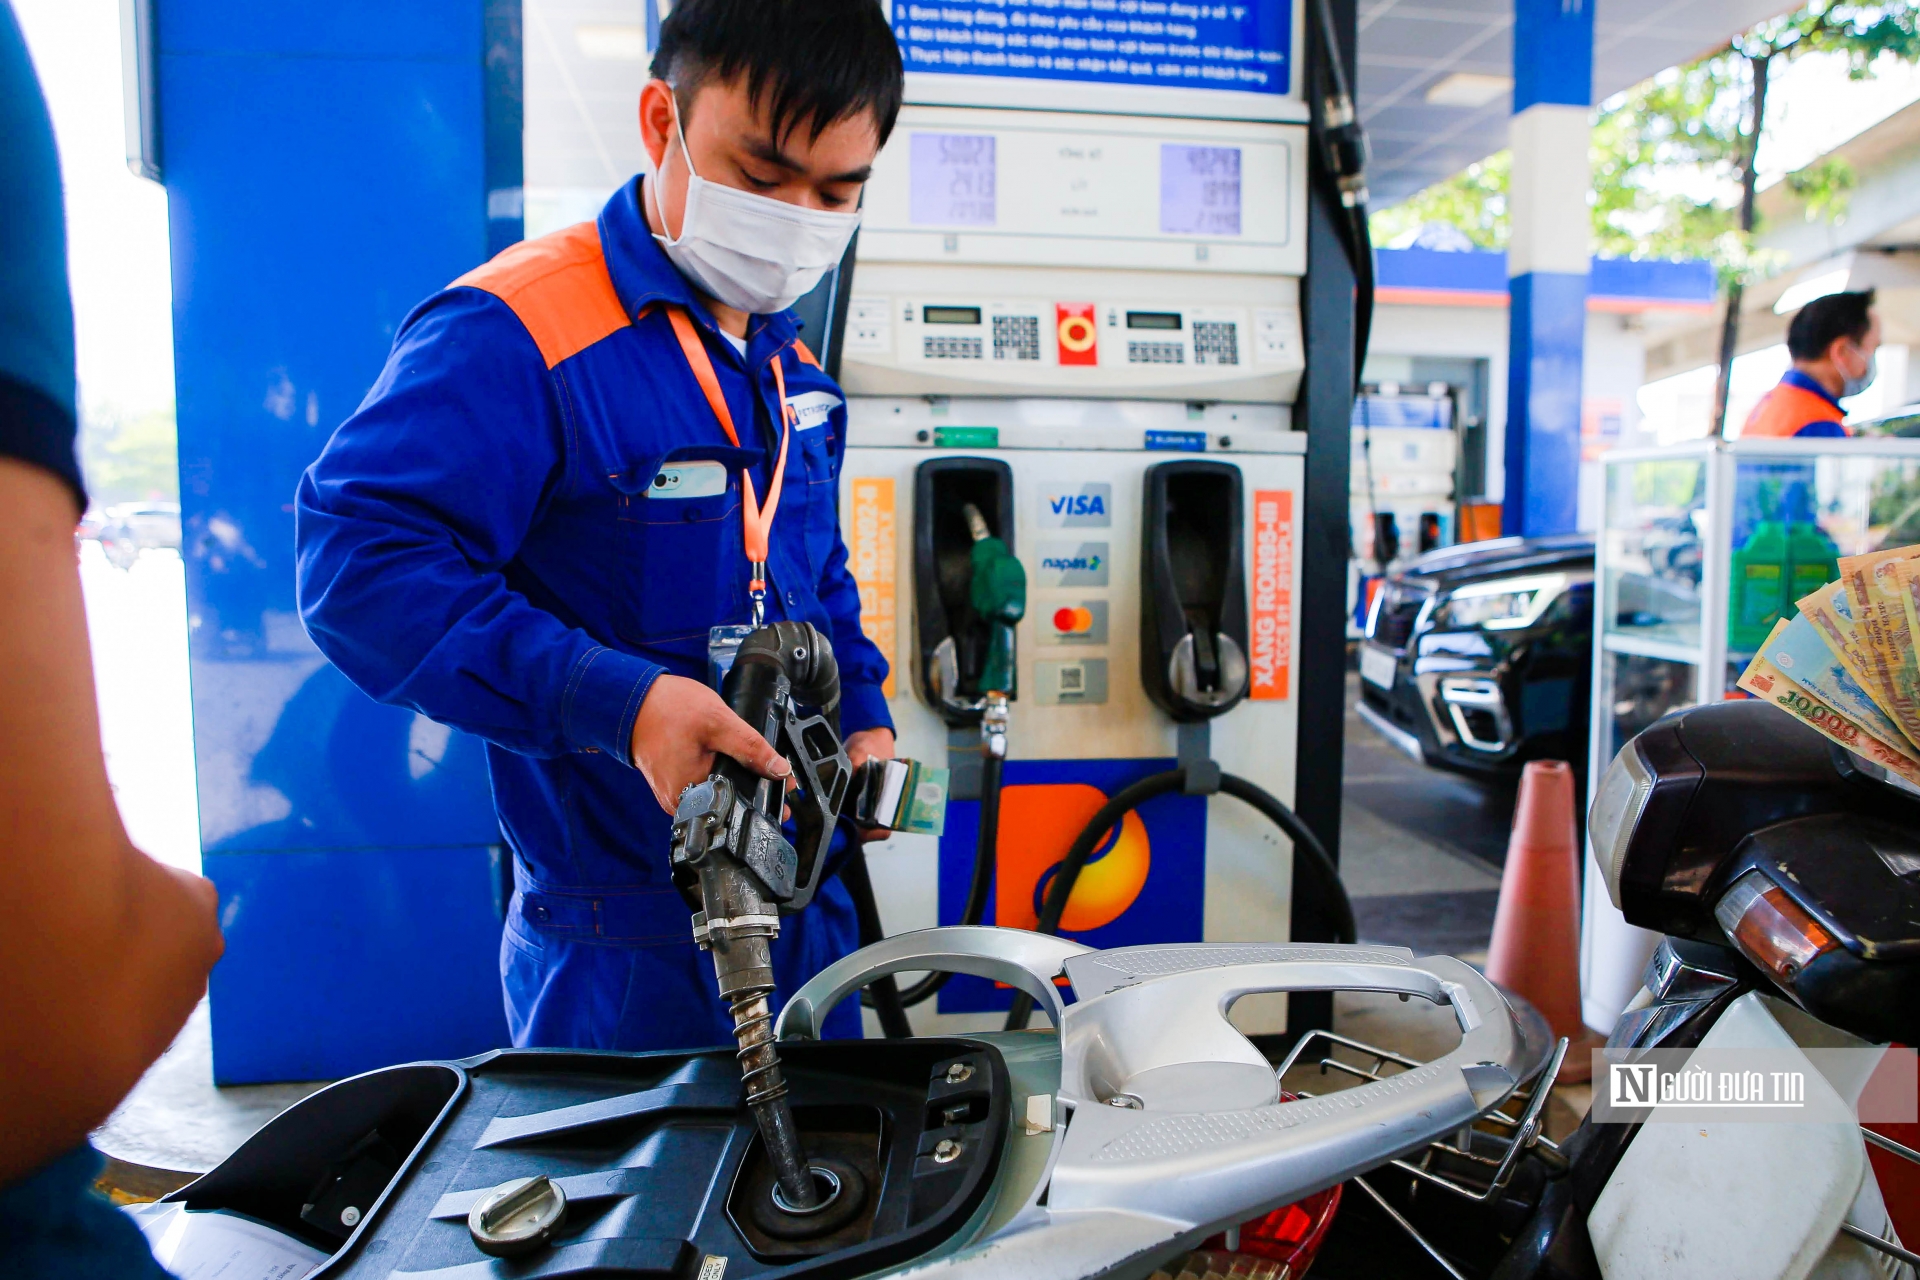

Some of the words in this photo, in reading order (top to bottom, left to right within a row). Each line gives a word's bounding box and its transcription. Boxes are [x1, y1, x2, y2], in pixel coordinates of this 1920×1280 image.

[1049, 495, 1105, 515] VISA
[1042, 557, 1088, 571] napas
[1256, 501, 1278, 612] RON95-III
[712, 1263, 721, 1279] ONLY
